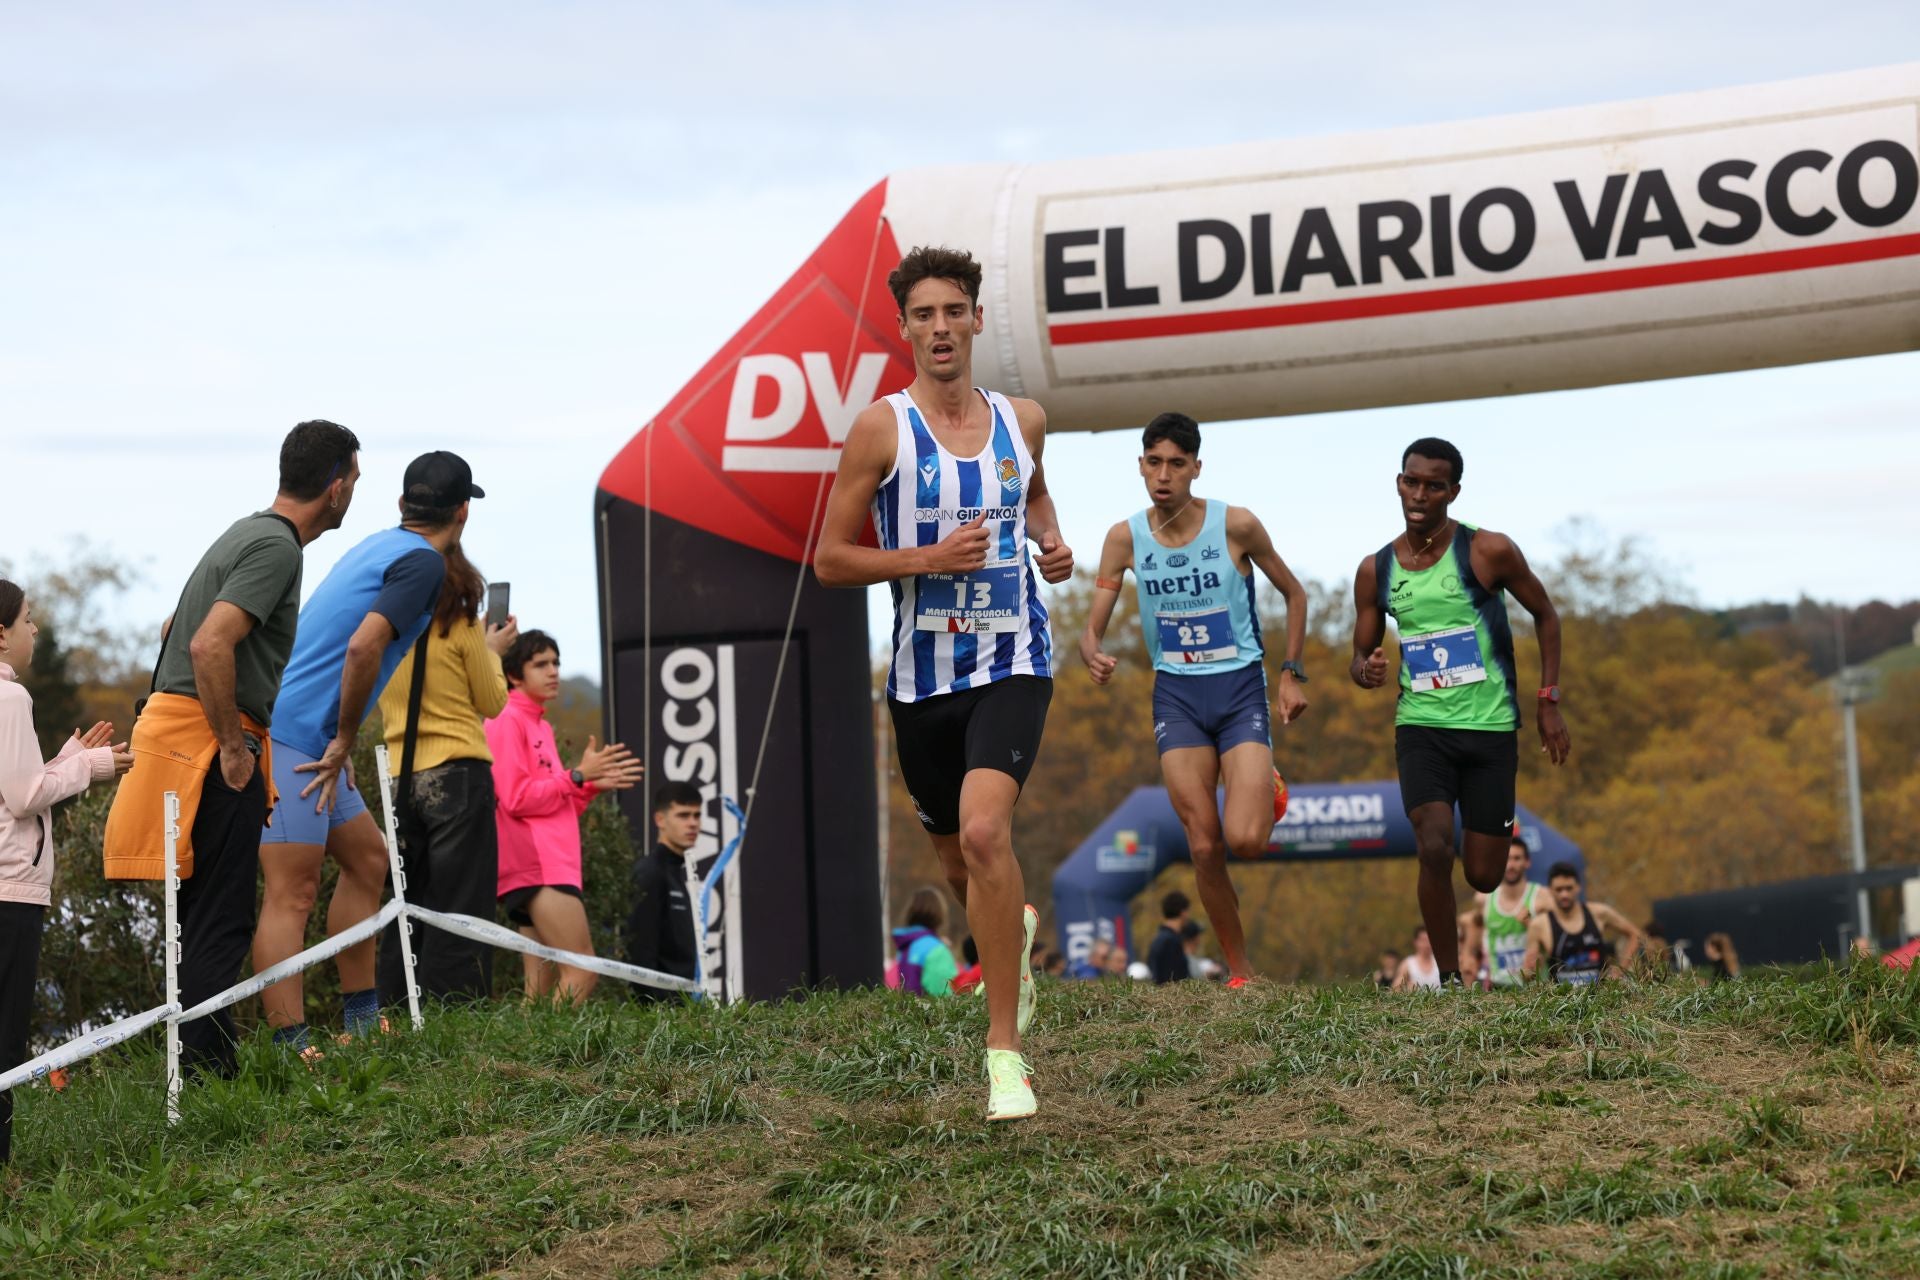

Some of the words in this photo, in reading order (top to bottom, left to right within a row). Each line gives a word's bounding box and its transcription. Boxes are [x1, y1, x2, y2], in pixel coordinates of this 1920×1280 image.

[1044, 227, 1159, 314] EL
[1177, 186, 1537, 303] DIARIO
[1553, 139, 1920, 262] VASCO
[723, 352, 889, 442] DV
[914, 509, 954, 520] ORAIN
[1144, 567, 1221, 597] nerja
[954, 582, 992, 609] 13
[1160, 597, 1213, 611] ATLETISMO
[1392, 591, 1413, 602] UCLM
[925, 607, 962, 617] MARTÍN
[1178, 625, 1210, 646] 23
[1433, 647, 1449, 669] 9
[1280, 794, 1384, 825] SKADI
